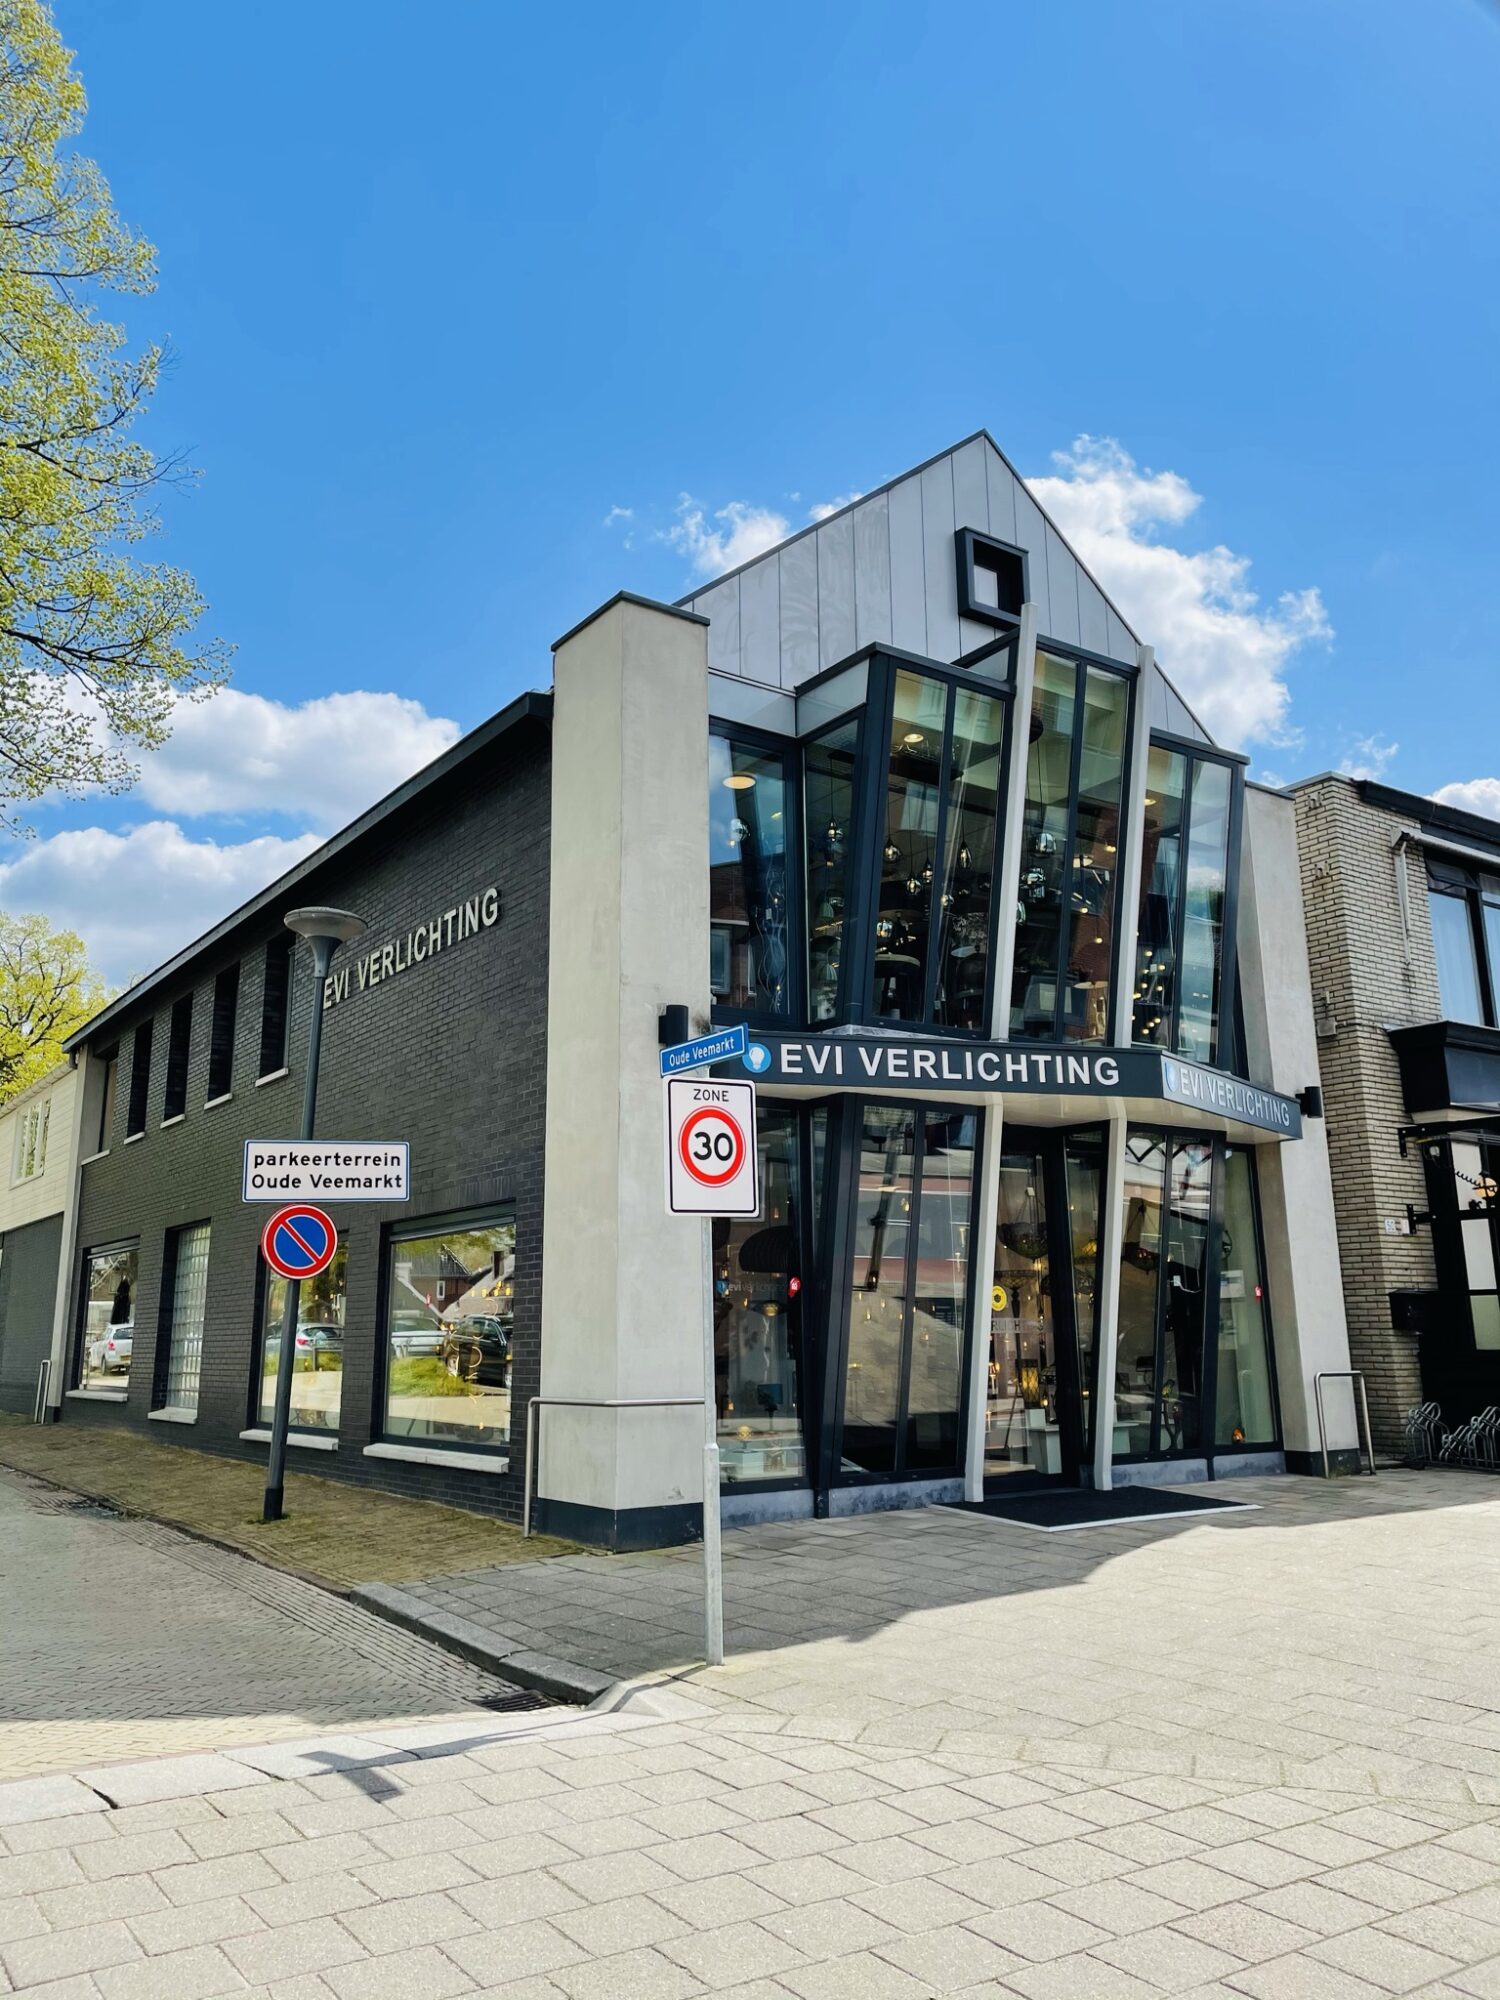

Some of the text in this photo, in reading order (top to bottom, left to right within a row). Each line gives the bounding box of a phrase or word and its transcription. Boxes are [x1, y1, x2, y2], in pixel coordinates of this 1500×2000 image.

[323, 887, 499, 1010] EVI VERLICHTING
[669, 1037, 734, 1067] Oude Veemarkt
[780, 1043, 1121, 1086] EVI VERLICHTING
[693, 1088, 730, 1102] ZONE
[1180, 1067, 1290, 1127] EVI VERLICHTING
[254, 1151, 401, 1169] parkeerterrein
[693, 1131, 733, 1161] 30
[252, 1173, 403, 1189] Oude Veemarkt
